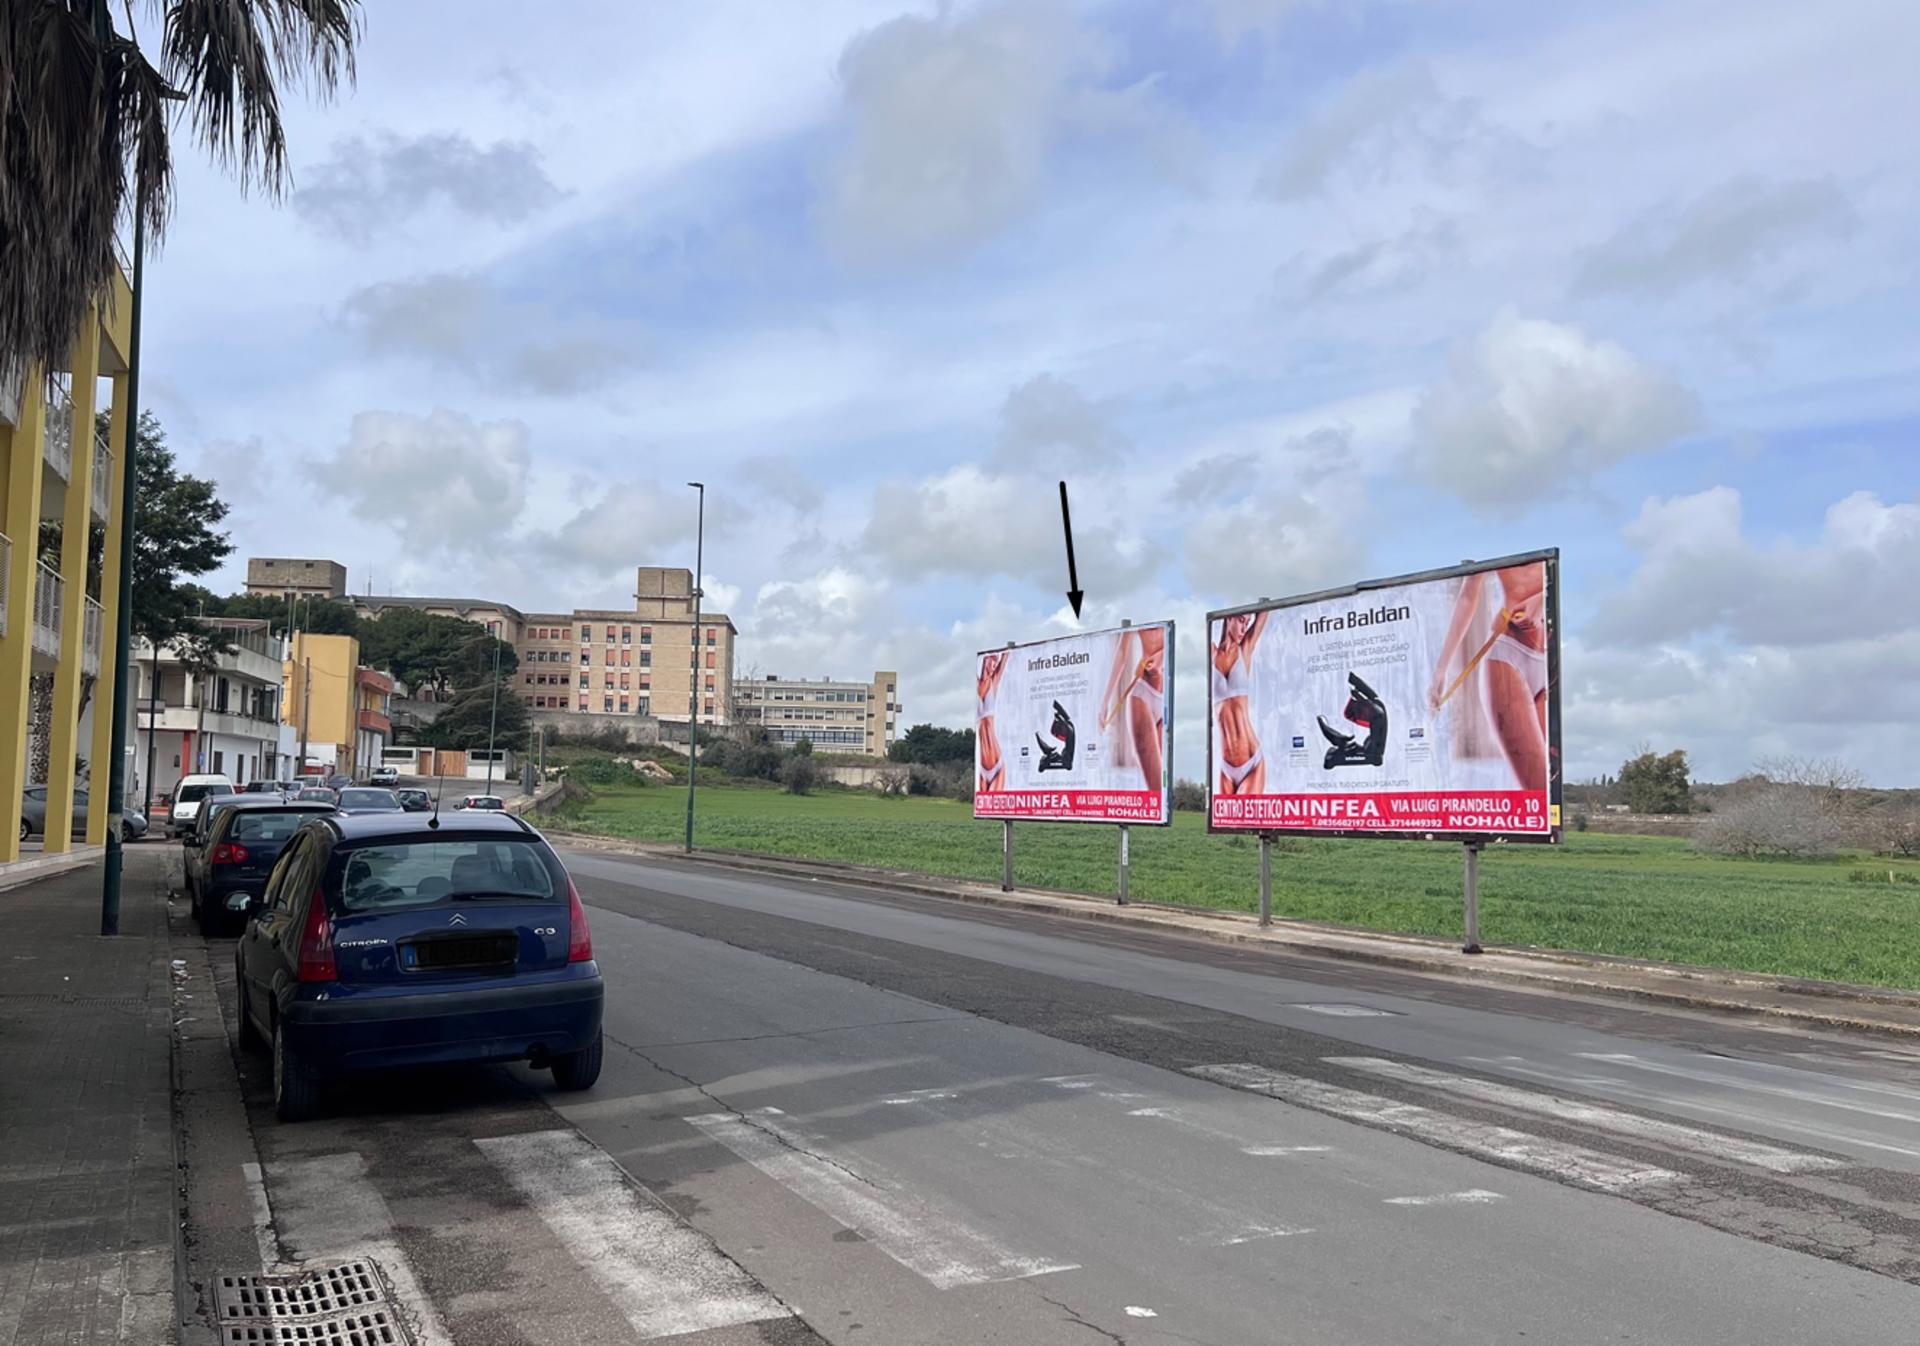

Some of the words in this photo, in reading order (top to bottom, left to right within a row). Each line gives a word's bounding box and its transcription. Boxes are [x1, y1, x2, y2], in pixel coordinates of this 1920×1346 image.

[1304, 615, 1344, 635] Infra
[1347, 606, 1410, 629] Baldan
[1052, 651, 1090, 668] Baldan
[1016, 794, 1071, 808] NINFEA
[1390, 799, 1409, 813] VIA
[1411, 799, 1440, 812] LUIGI
[1442, 799, 1511, 813] PIRANDELLO
[1525, 799, 1540, 813] 10
[1214, 799, 1243, 818] CENTRO
[1244, 799, 1283, 819] ESTETICO
[1284, 799, 1380, 817] NINFEA
[1449, 815, 1545, 829] NOHA(LE)
[534, 927, 556, 935] C3
